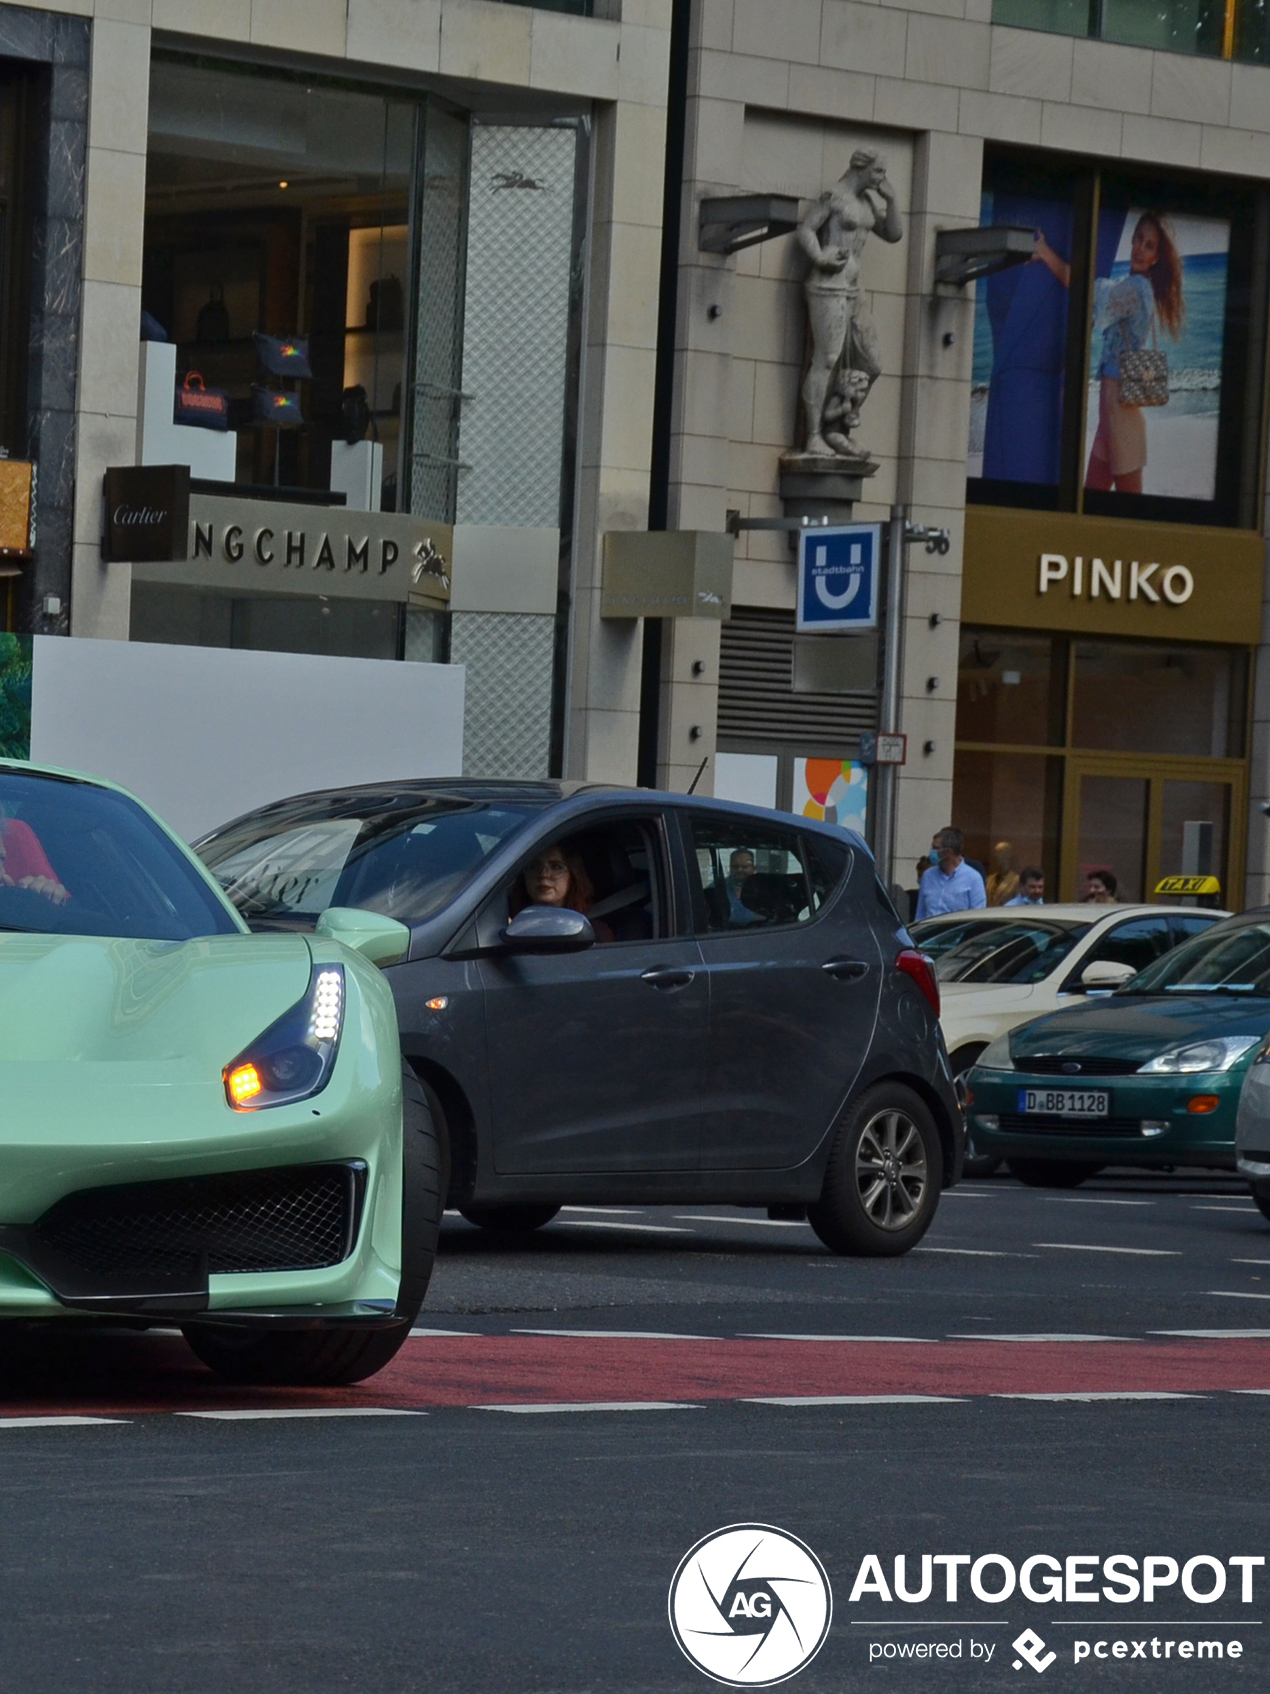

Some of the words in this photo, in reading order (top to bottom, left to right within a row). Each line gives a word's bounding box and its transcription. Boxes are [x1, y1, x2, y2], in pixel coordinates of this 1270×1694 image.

[113, 504, 167, 525] Cartier
[192, 521, 399, 575] NGCHAMP
[811, 564, 865, 576] stadtbahn
[1039, 553, 1194, 604] PINKO
[1160, 877, 1206, 890] TAXI
[1027, 1092, 1036, 1110] D
